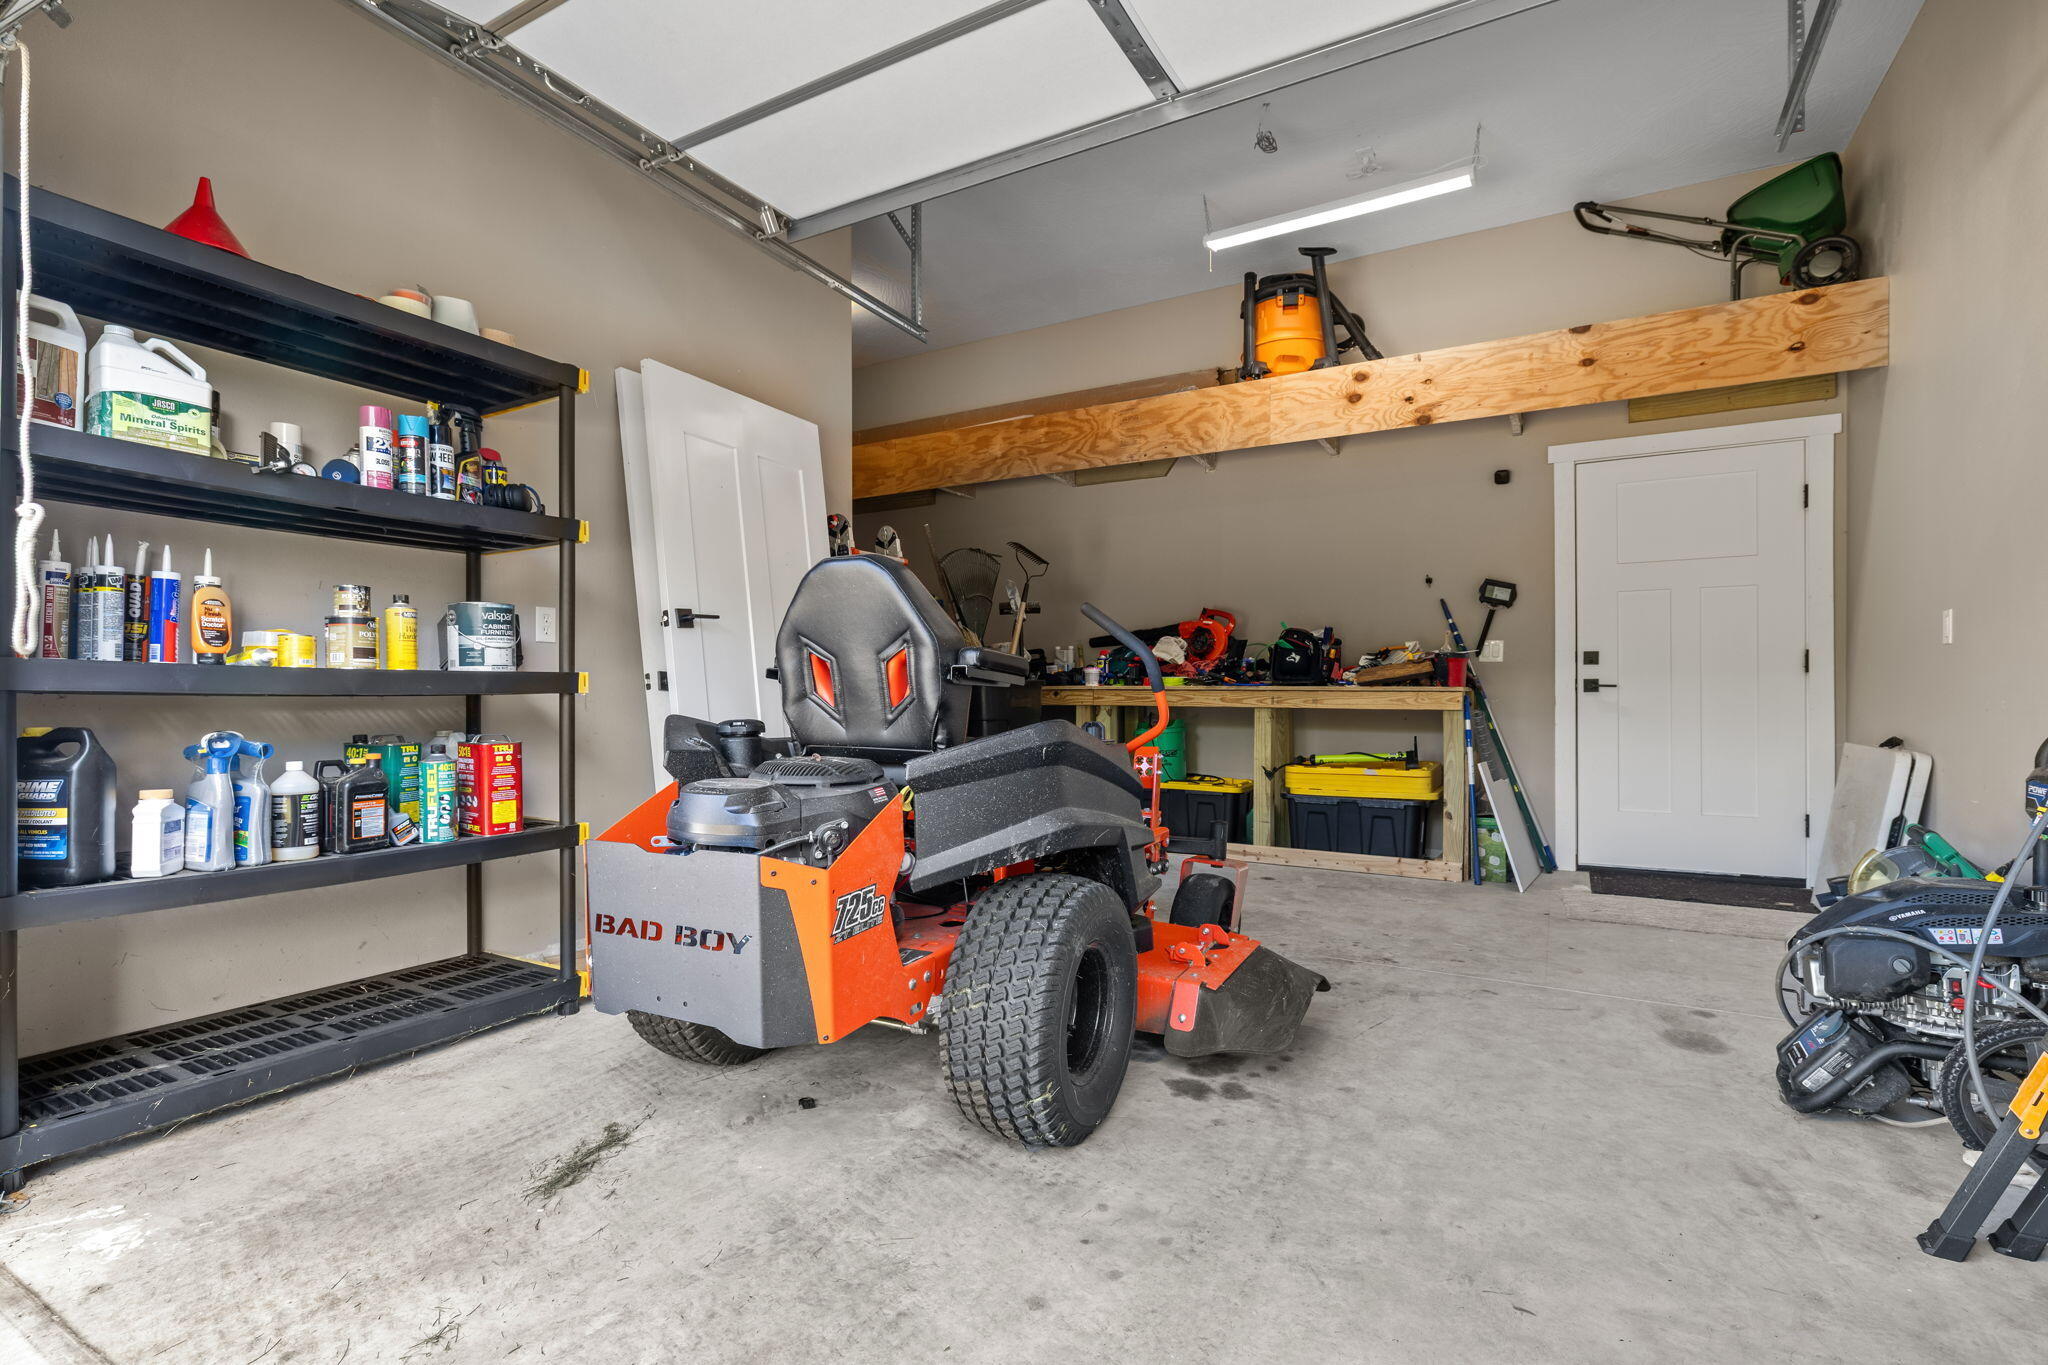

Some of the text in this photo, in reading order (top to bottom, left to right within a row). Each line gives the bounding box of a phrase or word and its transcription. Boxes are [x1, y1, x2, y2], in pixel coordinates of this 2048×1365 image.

[152, 399, 175, 411] JASCO
[120, 413, 166, 428] Mineral
[170, 422, 206, 436] Spirits
[129, 582, 142, 618] QUAD
[45, 602, 54, 624] KITCHEN
[481, 610, 513, 622] valspar
[346, 748, 364, 758] 40:1
[400, 745, 418, 753] TRU
[492, 744, 513, 752] TRU
[17, 781, 61, 793] RIME
[18, 792, 56, 800] GUARD
[427, 763, 438, 839] TRUFUEL
[1896, 909, 1926, 919] YAMAHA
[595, 913, 753, 955] BAD BOY
